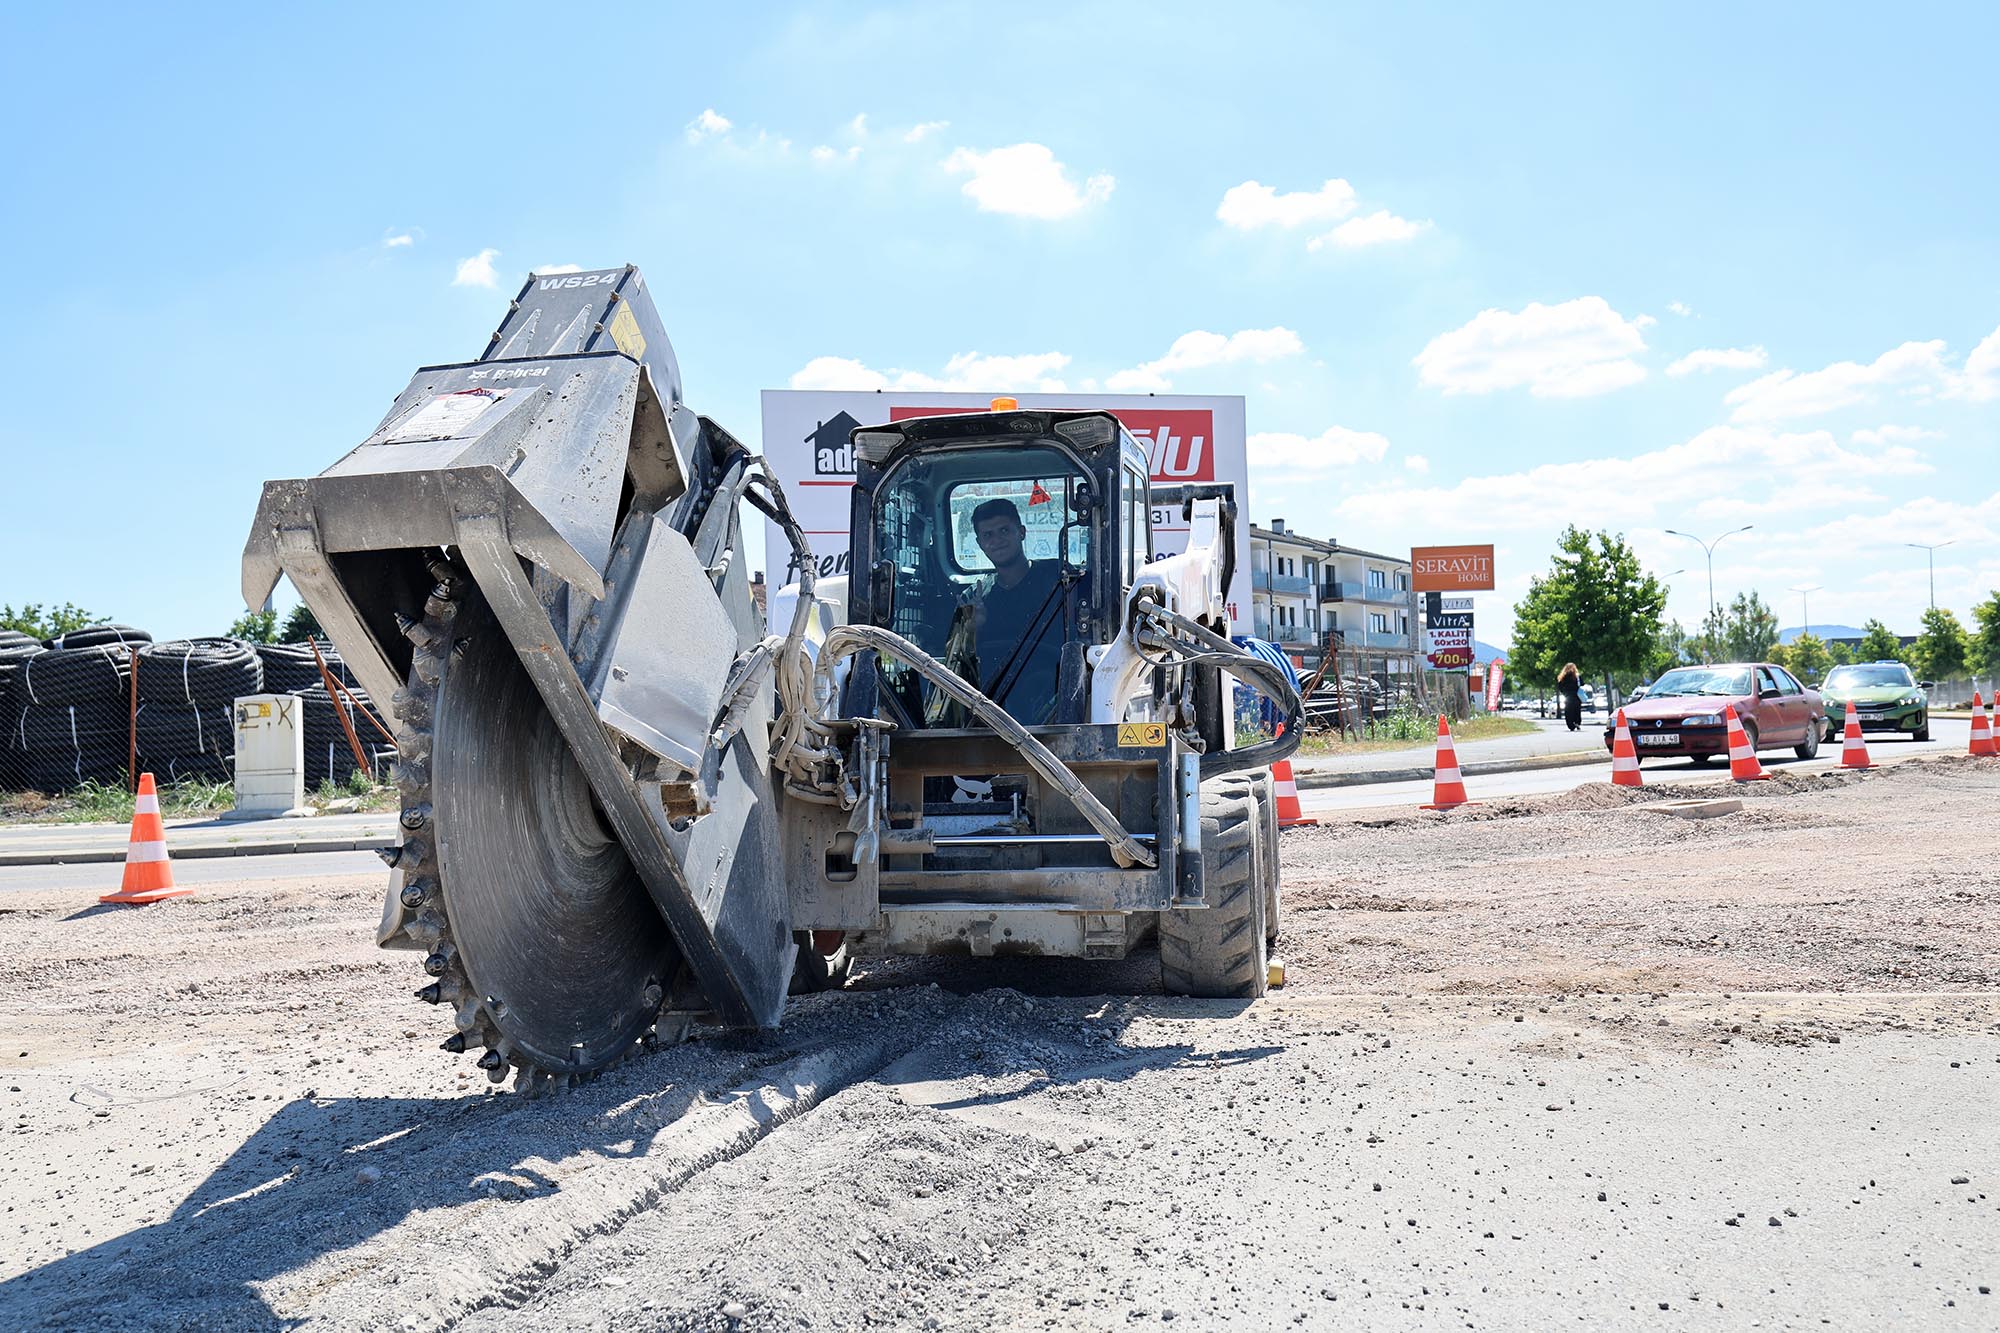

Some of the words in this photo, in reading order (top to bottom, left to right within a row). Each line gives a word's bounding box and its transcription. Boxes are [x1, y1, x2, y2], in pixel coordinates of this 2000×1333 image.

[540, 273, 617, 290] WS24
[492, 366, 550, 380] Bobcat
[1416, 555, 1490, 573] SERAVİT
[1458, 572, 1489, 583] HOME
[1436, 654, 1460, 665] 700
